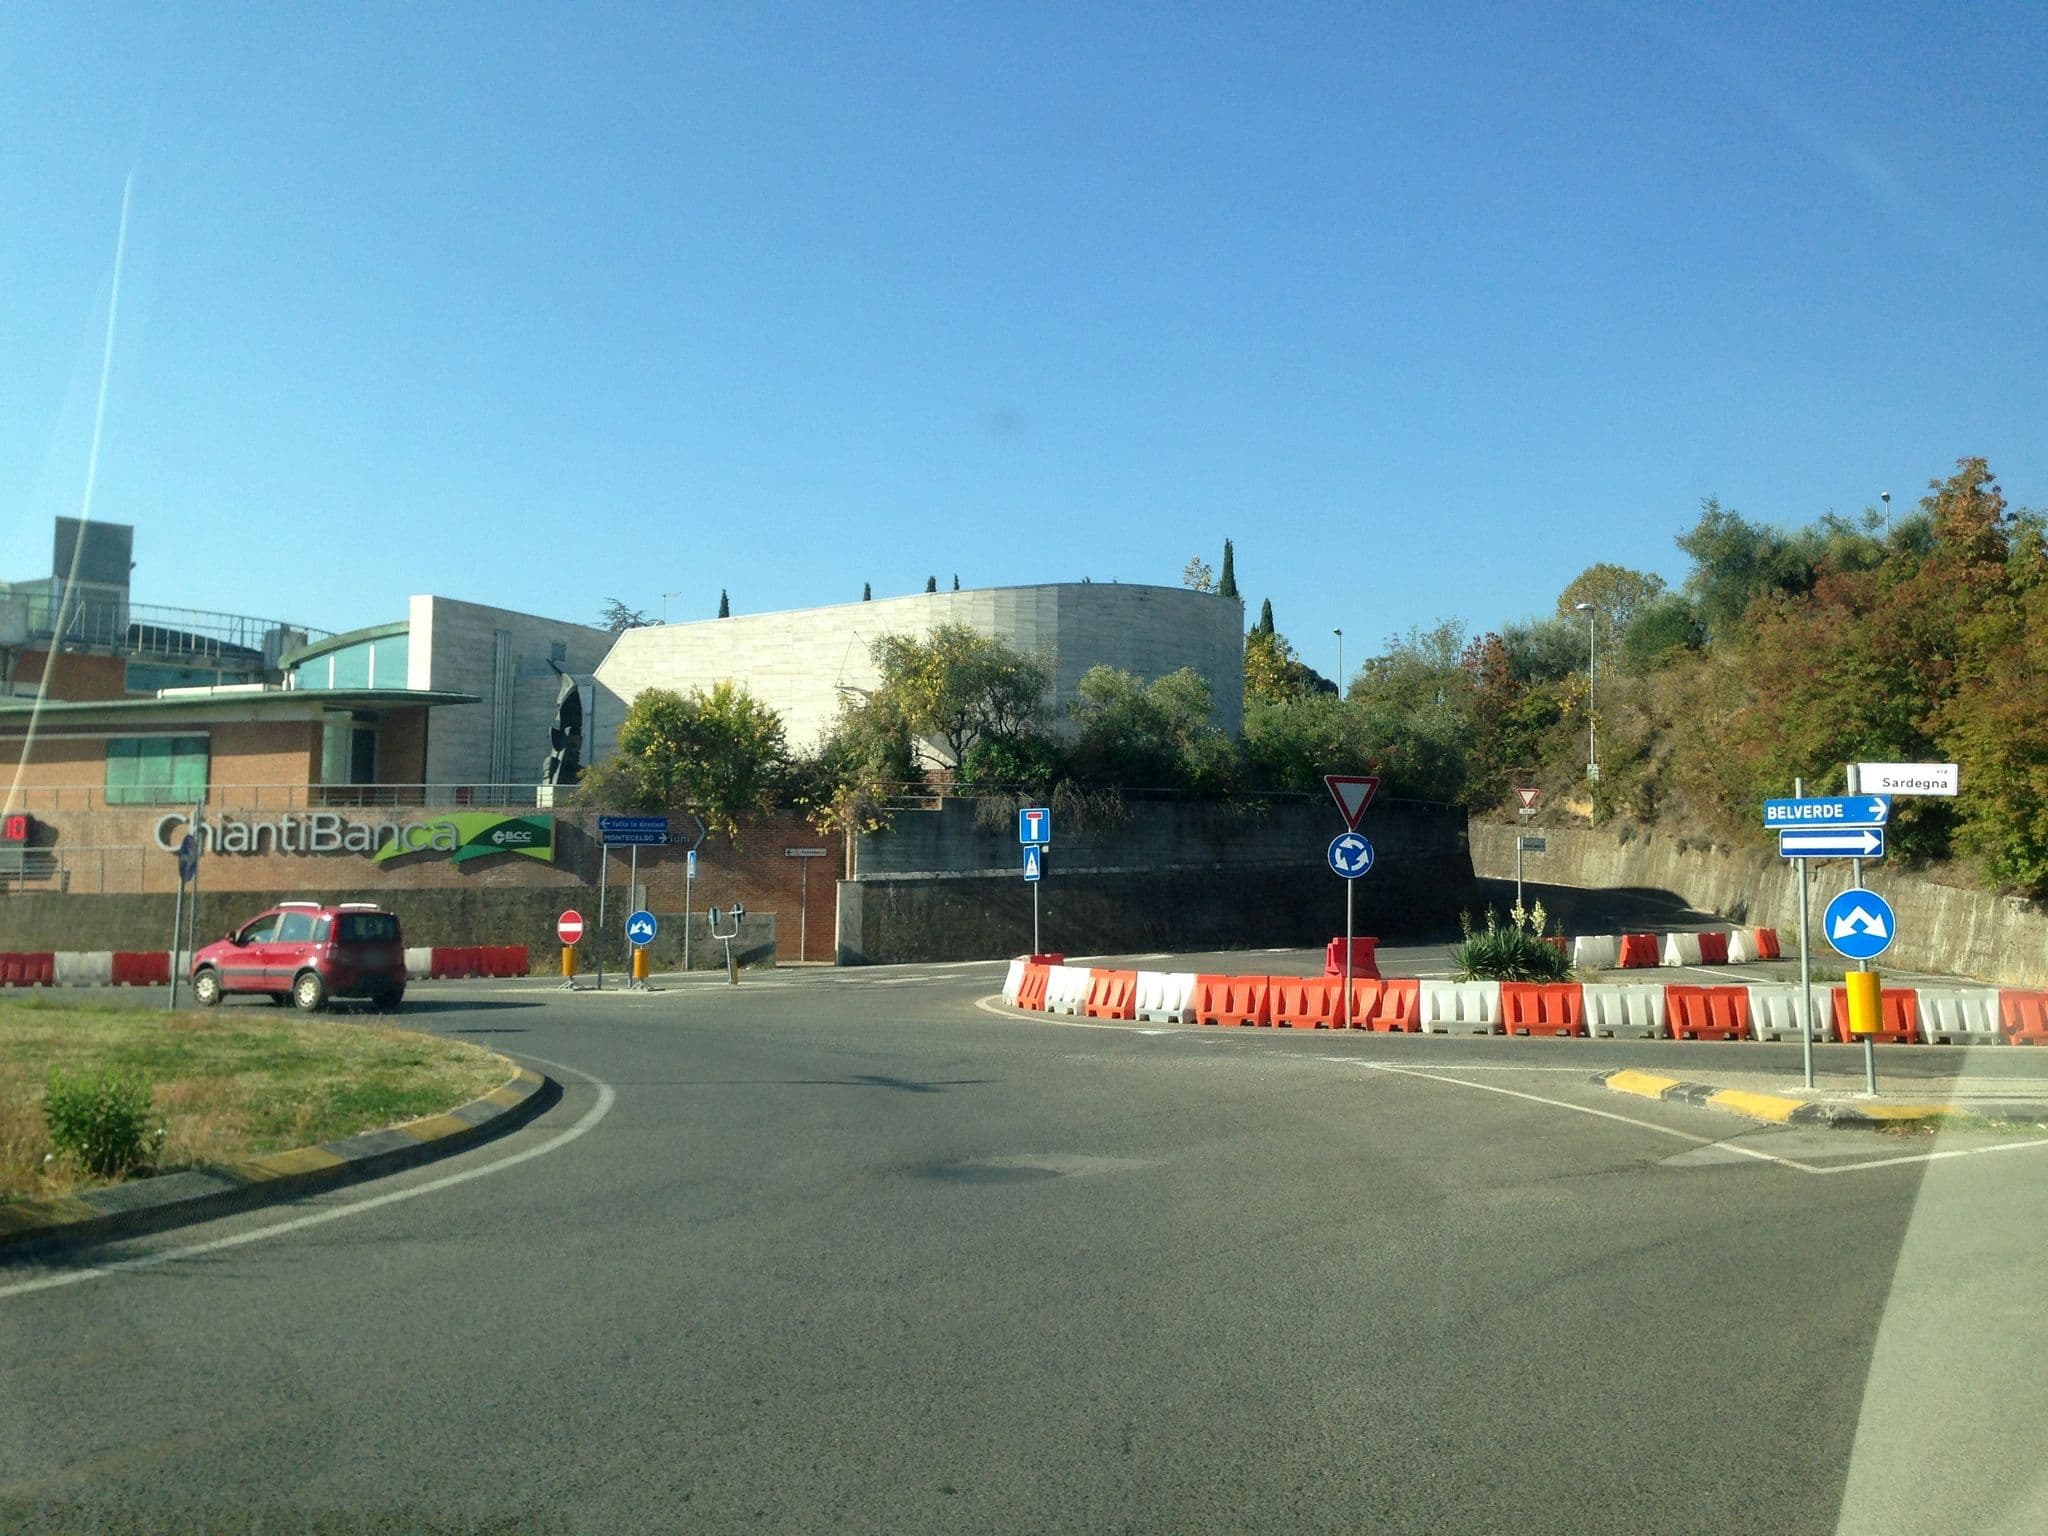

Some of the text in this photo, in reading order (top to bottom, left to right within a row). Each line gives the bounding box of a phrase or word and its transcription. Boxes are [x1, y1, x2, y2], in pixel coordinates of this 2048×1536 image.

[1882, 777, 1948, 791] Sardegna
[1767, 804, 1844, 820] BELVERDE
[153, 811, 458, 852] ChiantiBanca
[505, 831, 532, 840] BCC
[604, 834, 655, 842] MONTECELSO
